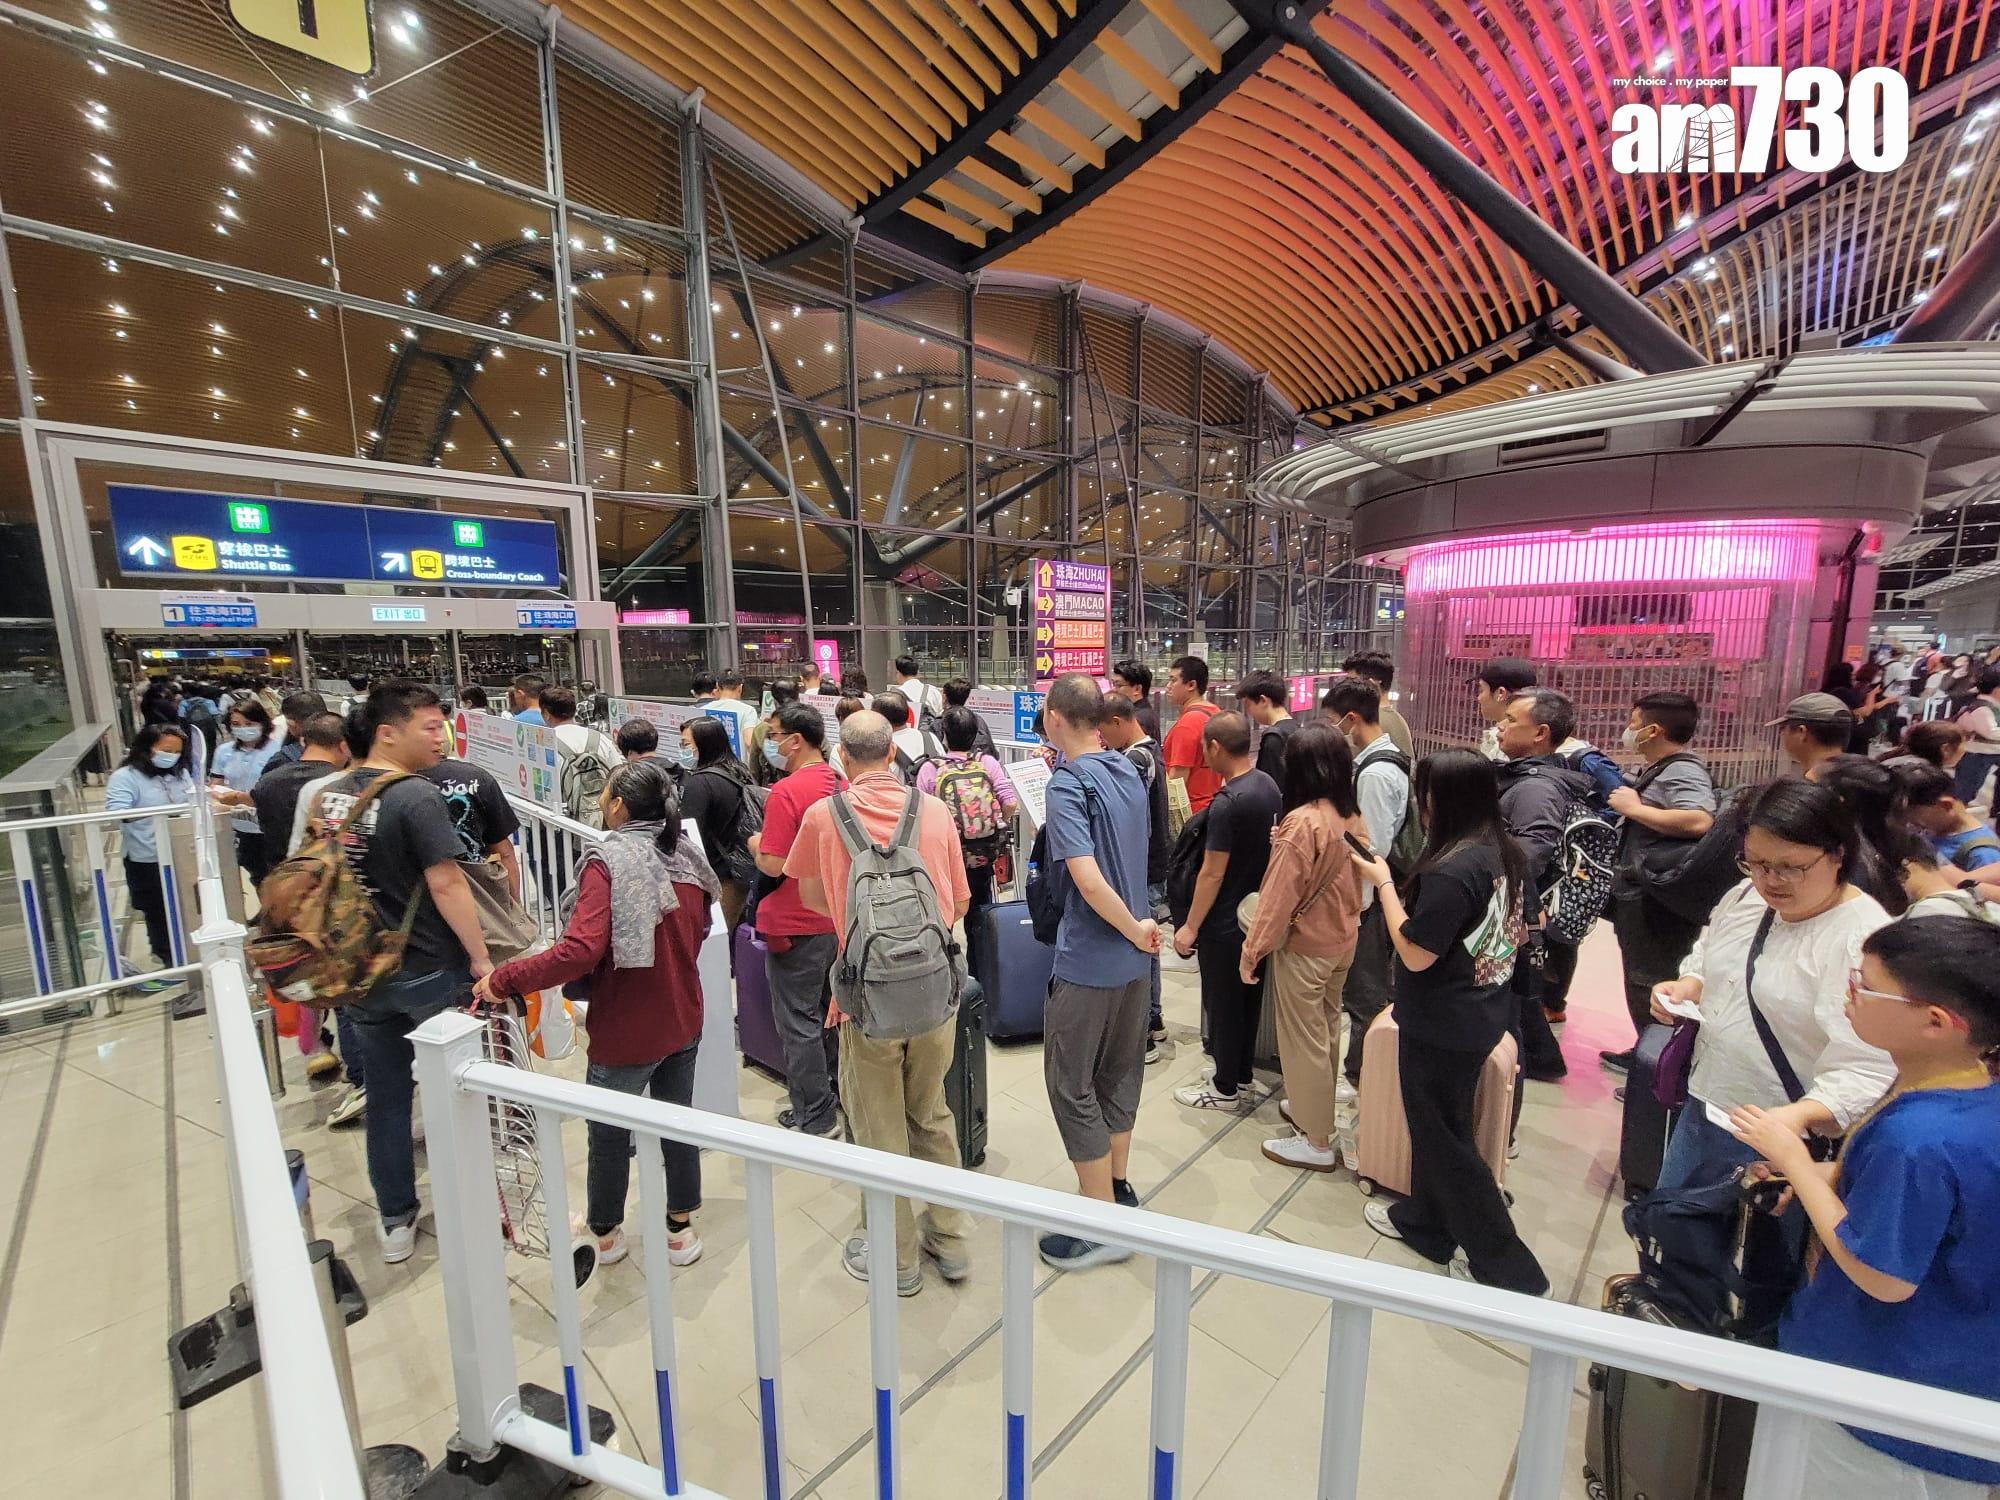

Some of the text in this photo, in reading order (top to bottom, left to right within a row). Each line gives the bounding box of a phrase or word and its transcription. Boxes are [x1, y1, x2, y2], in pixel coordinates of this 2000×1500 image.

[218, 541, 288, 558] 穿梭巴士
[221, 559, 293, 571] Shuttle Bus
[445, 554, 496, 568] 跨境巴士
[446, 570, 544, 582] Cross-boundary Coach
[1043, 599, 1049, 609] 2
[168, 608, 178, 620] 1
[376, 608, 421, 619] EXIT 出口
[521, 612, 528, 623] 1
[1043, 629, 1048, 639] 3
[1042, 658, 1048, 668] 4
